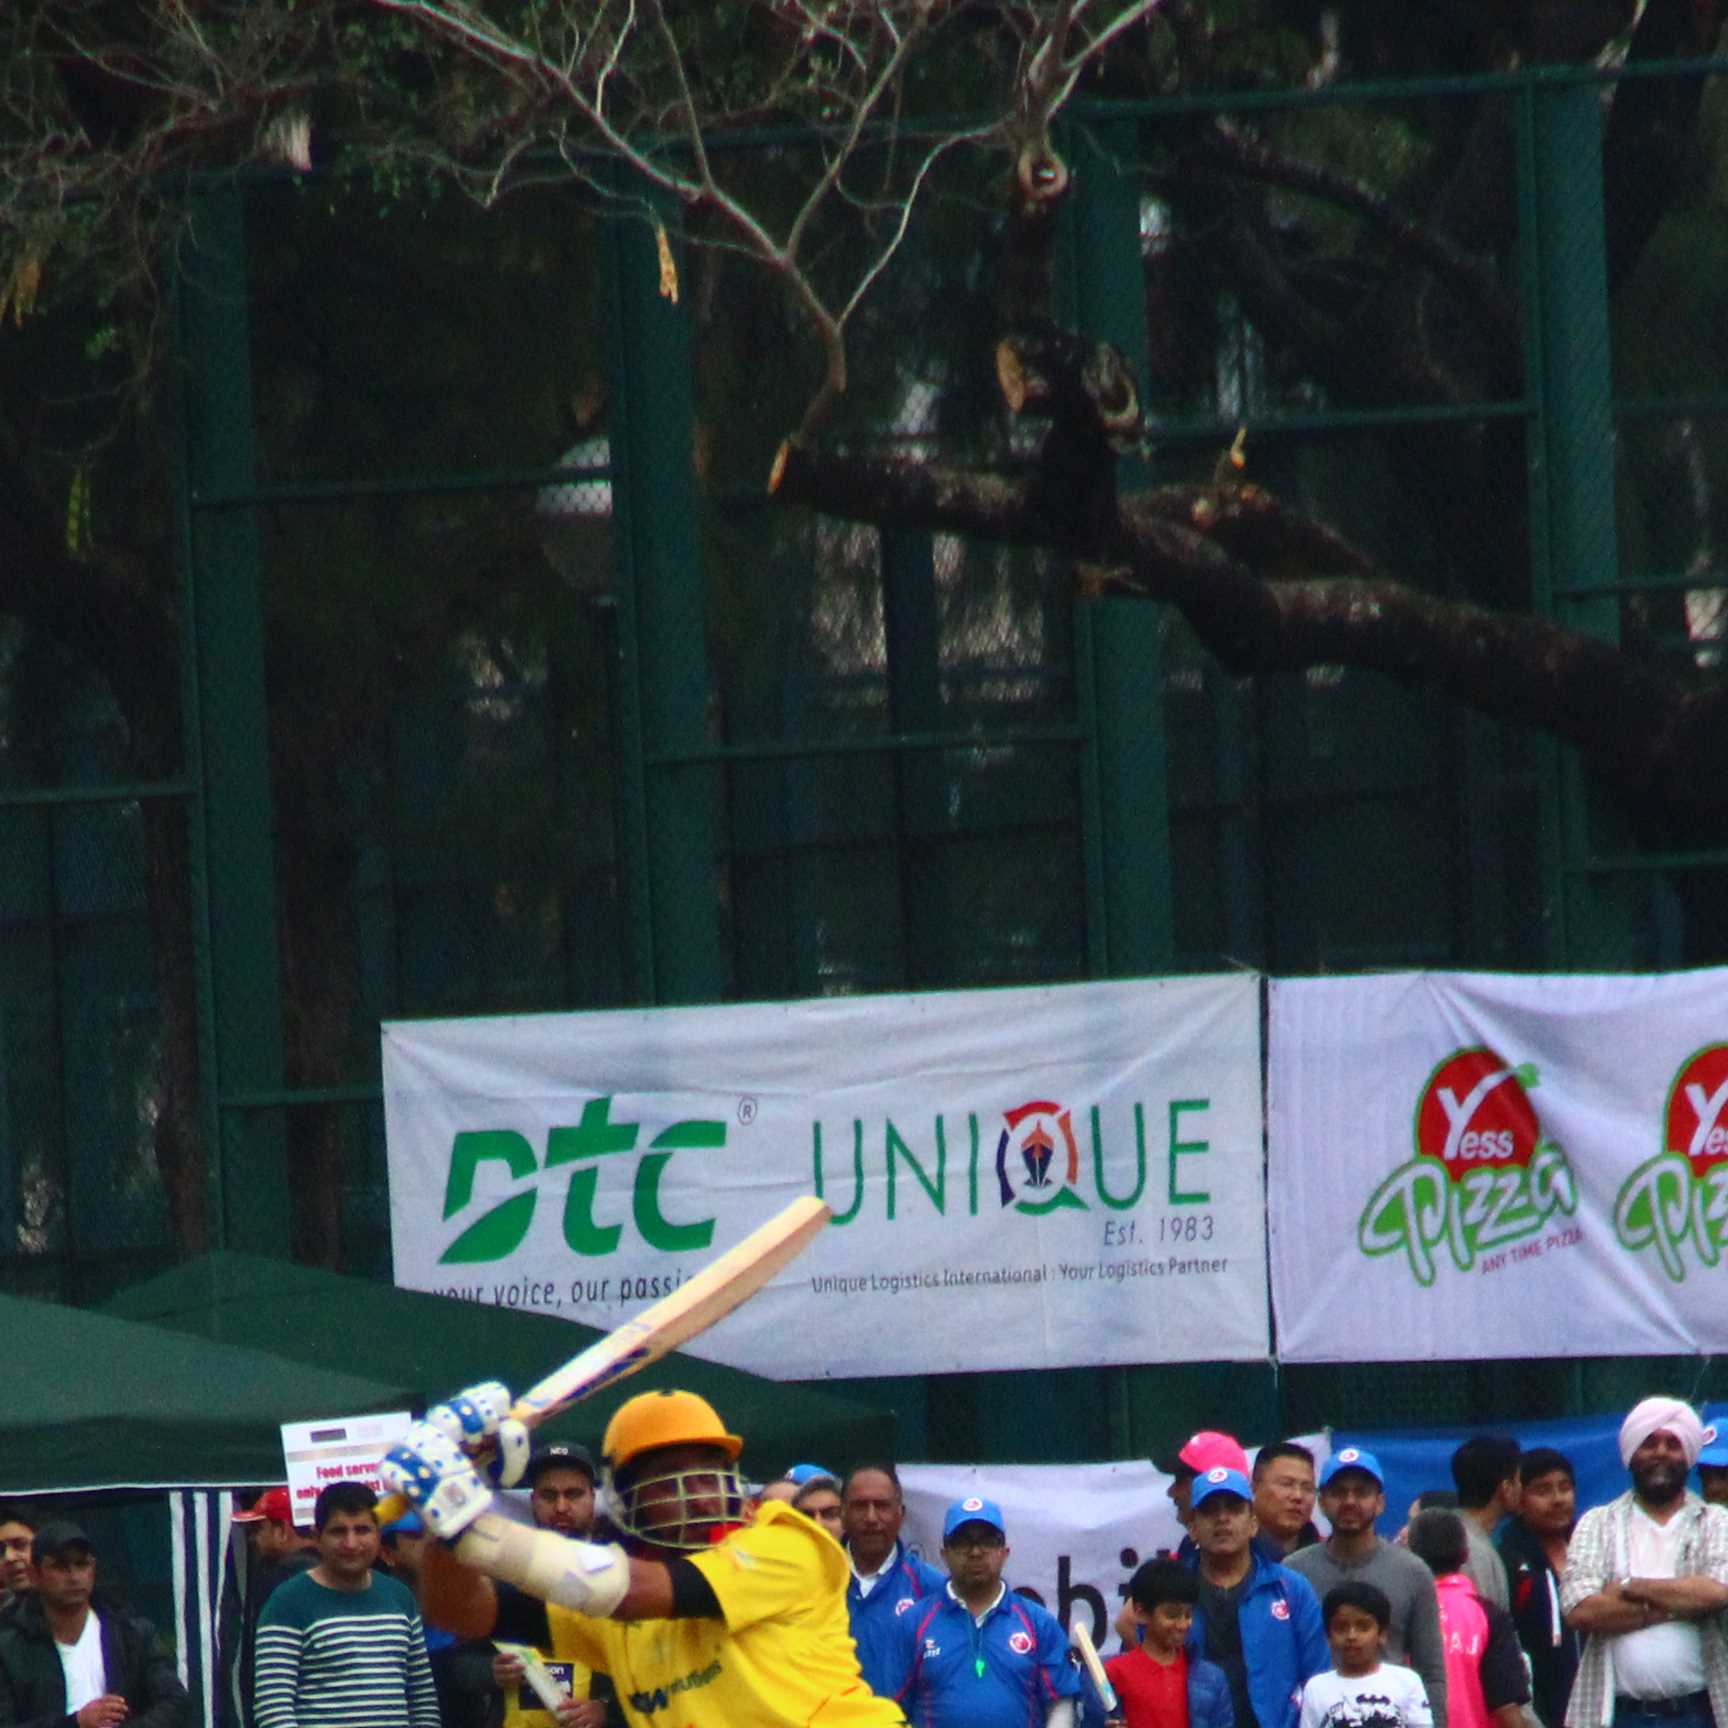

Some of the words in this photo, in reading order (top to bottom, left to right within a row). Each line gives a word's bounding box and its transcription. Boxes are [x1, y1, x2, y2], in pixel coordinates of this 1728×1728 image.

[1437, 1069, 1515, 1160] Yess
[812, 1098, 1212, 1226] UNIQUE
[1104, 1218, 1143, 1247] Est.
[1158, 1215, 1215, 1243] 1983
[1359, 1142, 1577, 1287] Pizza
[494, 1277, 562, 1307] voice,
[571, 1280, 609, 1303] our
[621, 1268, 693, 1307] passi
[811, 1273, 868, 1295] Unique
[871, 1273, 940, 1295] Logistics
[943, 1268, 1047, 1289] International
[1058, 1263, 1096, 1282] Your
[1098, 1261, 1165, 1283] Logistics
[1168, 1257, 1229, 1276] Partner
